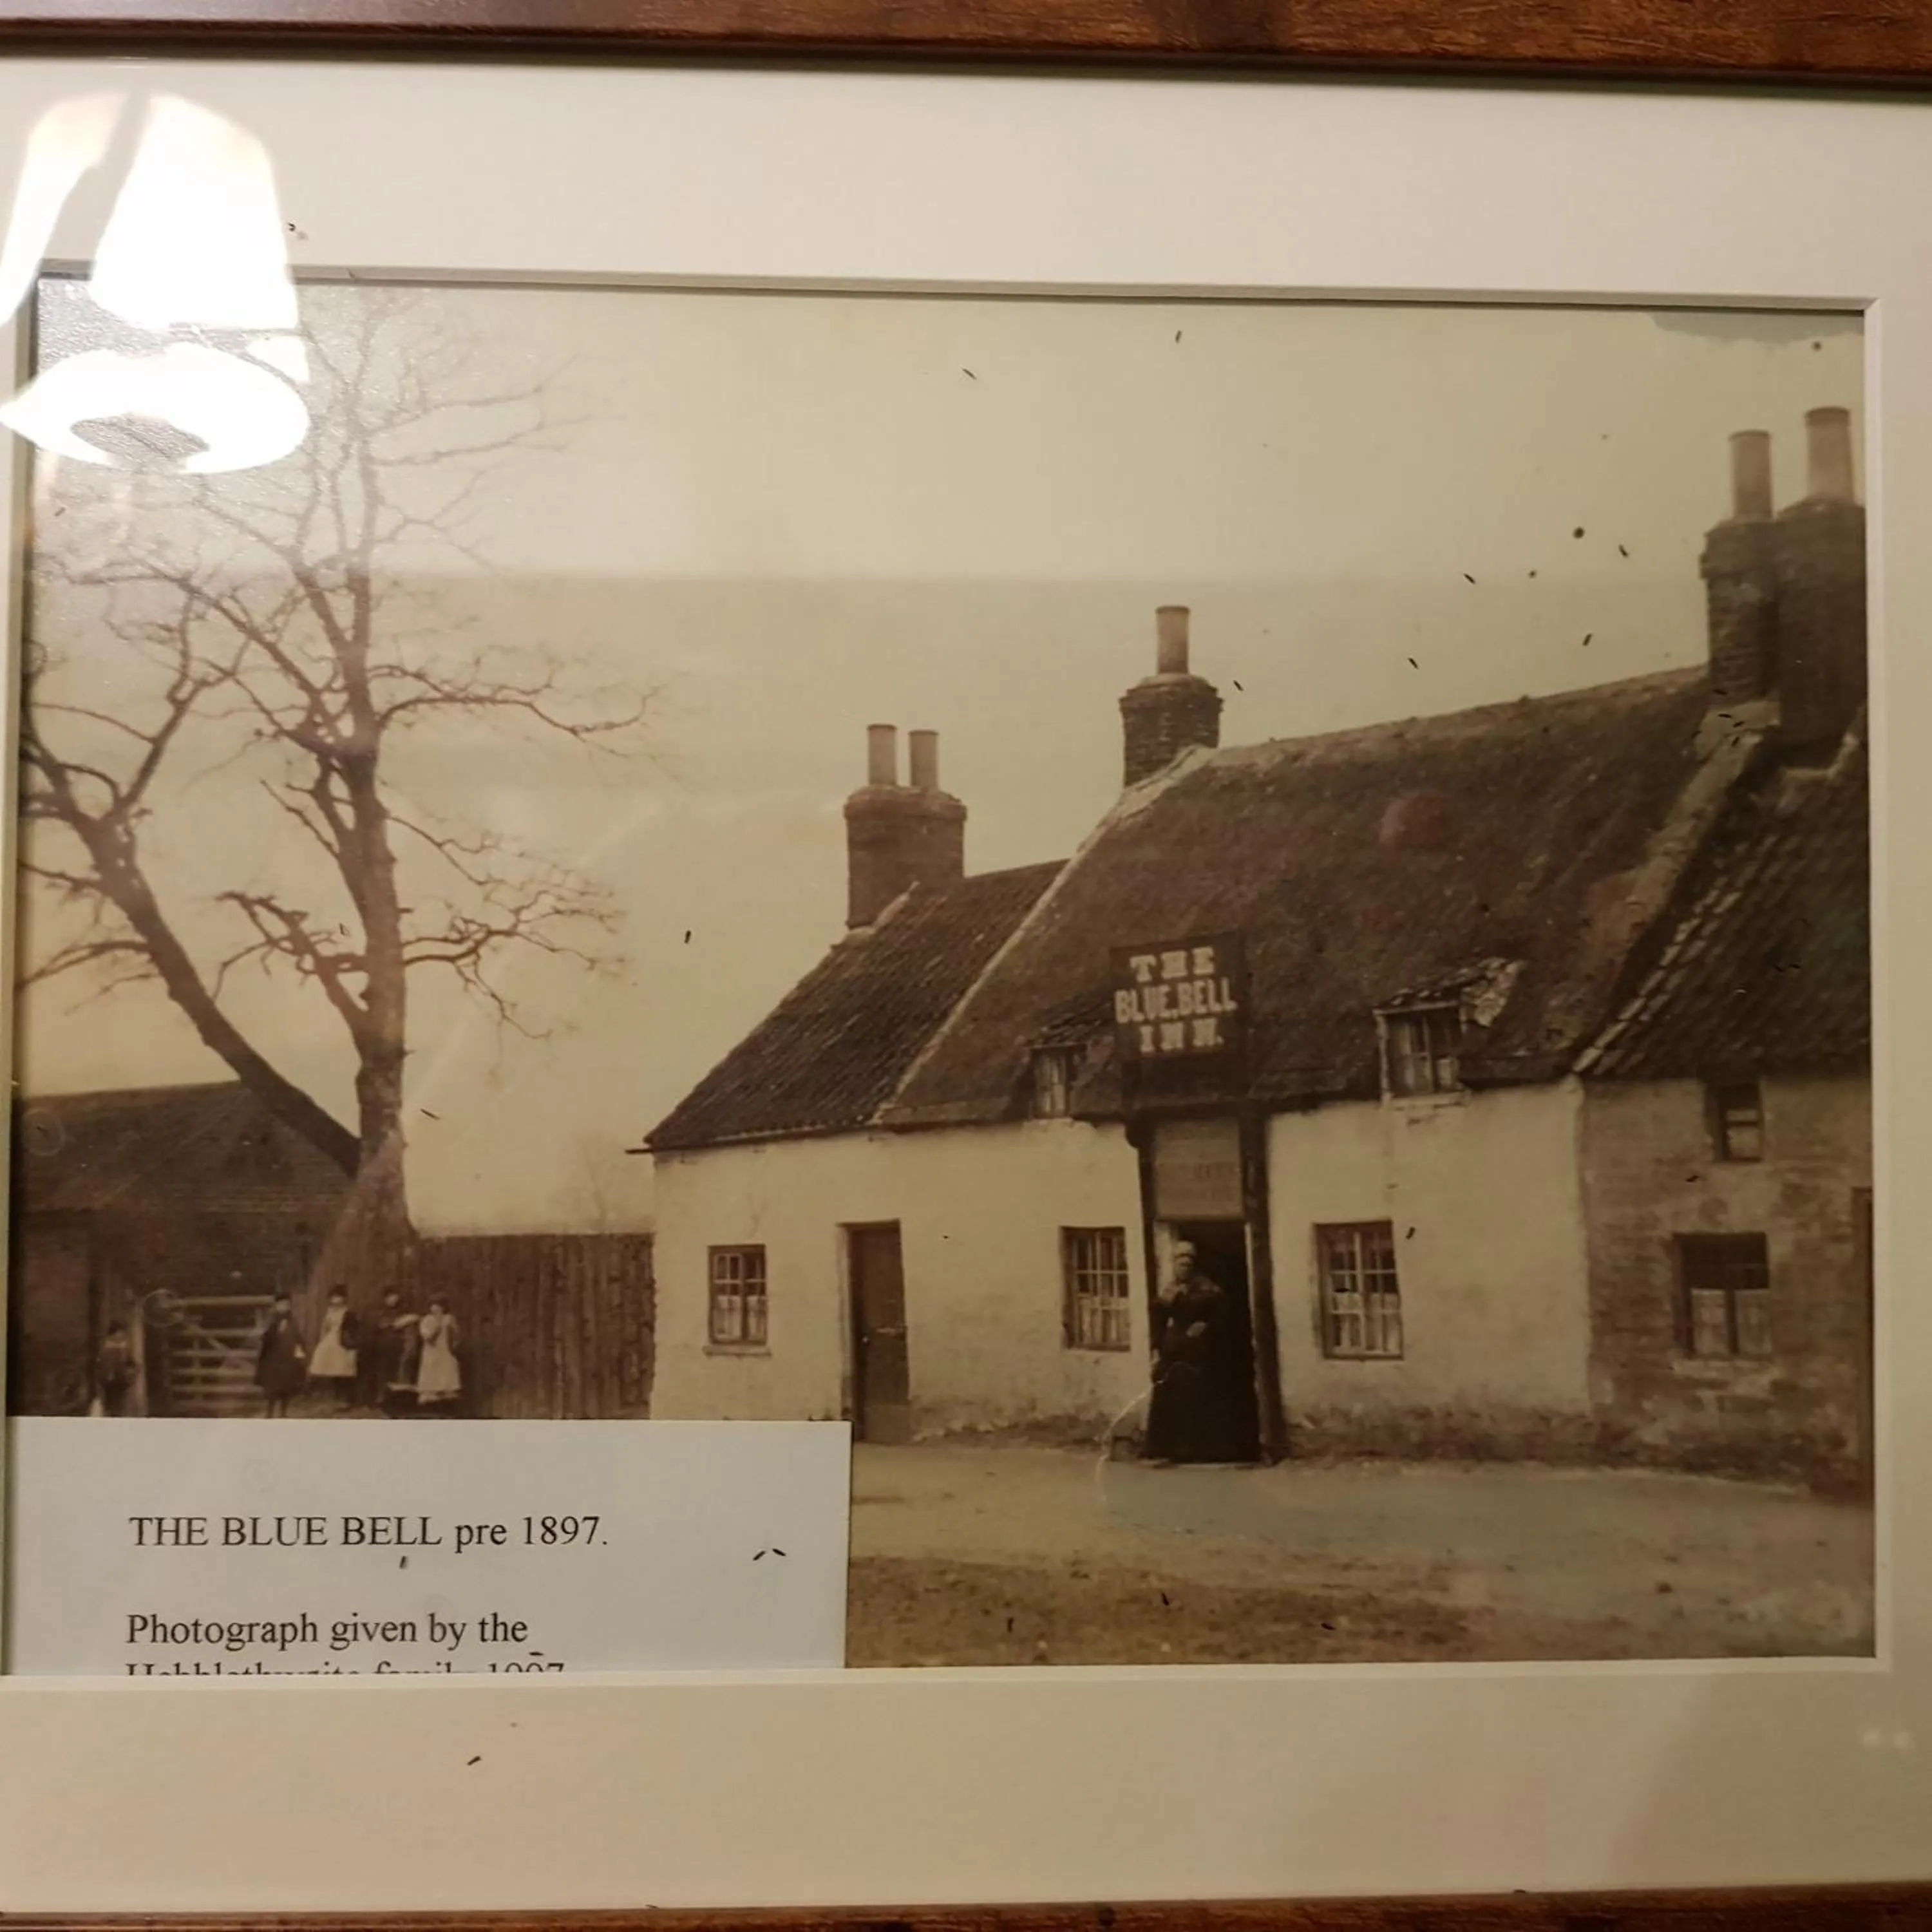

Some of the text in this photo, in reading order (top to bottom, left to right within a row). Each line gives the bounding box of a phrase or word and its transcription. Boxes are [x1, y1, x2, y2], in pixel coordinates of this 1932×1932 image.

[1130, 946, 1215, 982] THE
[1178, 976, 1237, 1016] BELL
[128, 1515, 607, 1553] THE BLUE BELL pre 1897.
[126, 1612, 528, 1651] Photograph given by the
